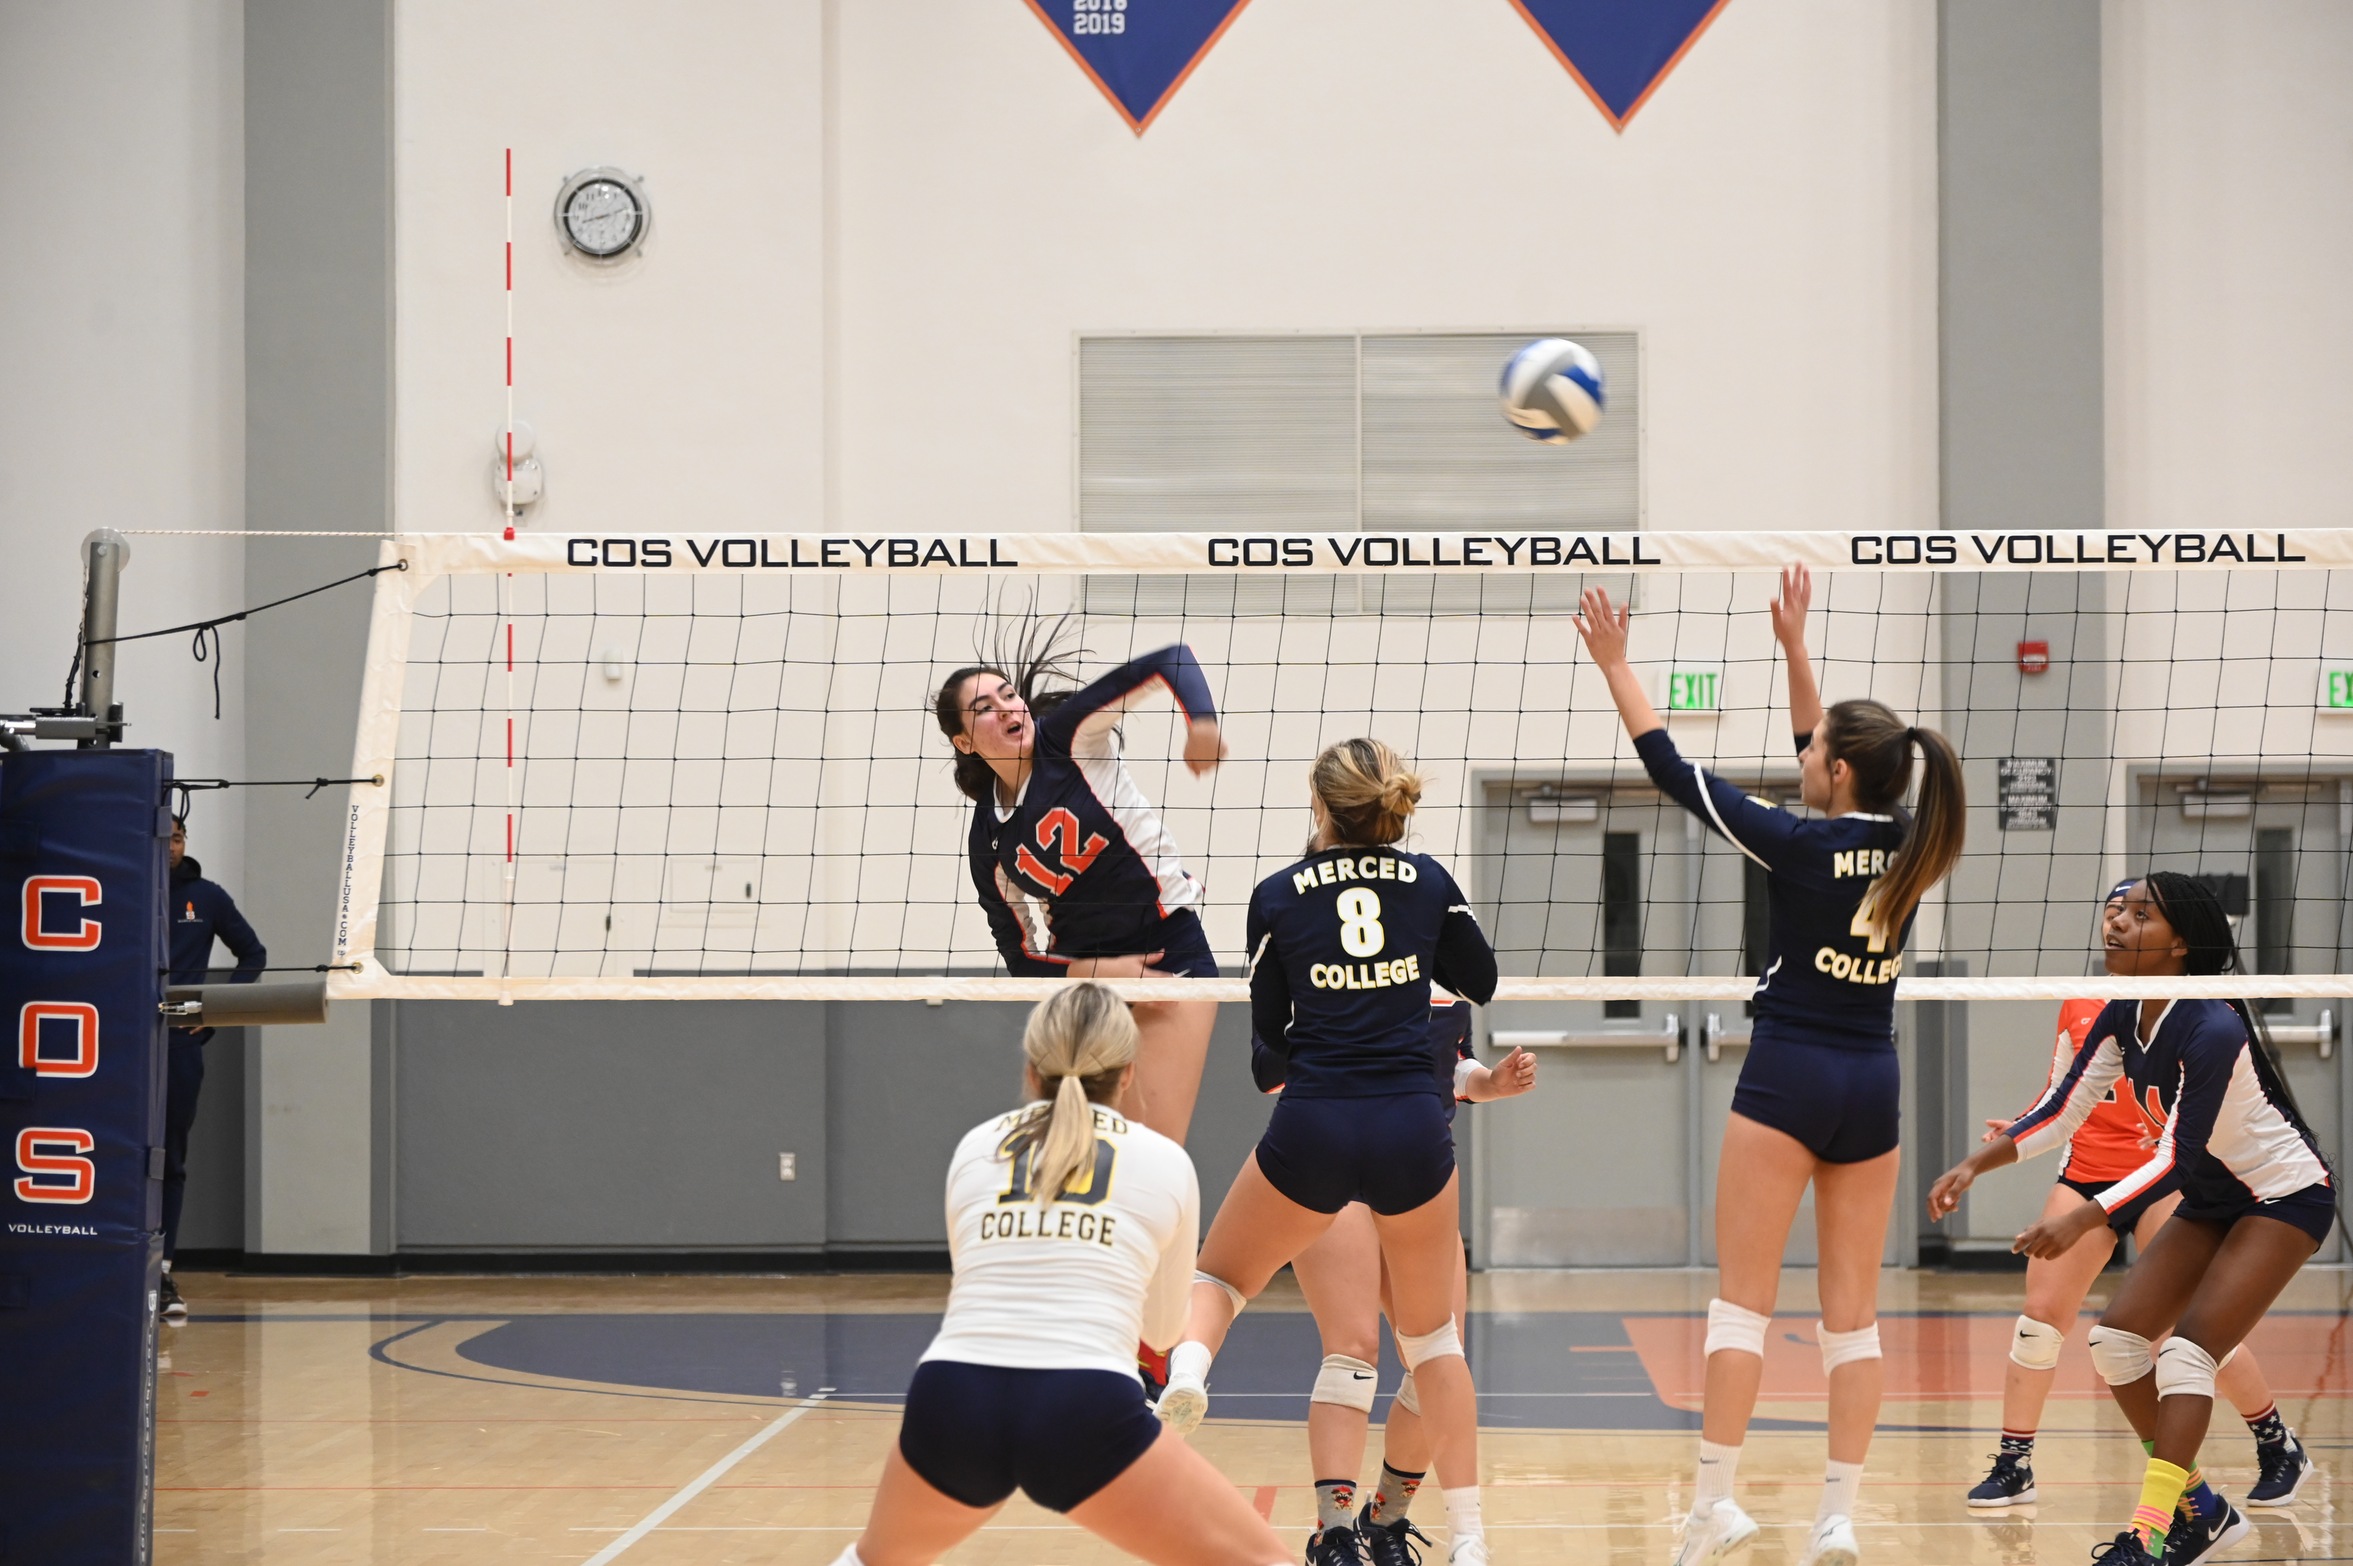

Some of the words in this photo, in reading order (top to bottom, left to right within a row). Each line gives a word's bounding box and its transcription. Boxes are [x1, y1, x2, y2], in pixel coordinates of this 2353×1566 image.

[1074, 12, 1126, 35] 2019
[567, 538, 672, 568] COS
[686, 538, 1019, 568] VOLLEYBALL
[1208, 537, 1314, 567] COS
[1327, 536, 1661, 567] VOLLEYBALL
[1851, 535, 1957, 565] COS
[1971, 533, 2307, 564] VOLLEYBALL
[1669, 673, 1718, 709] EXIT
[1015, 807, 1110, 897] 12
[1292, 856, 1418, 895] MERCED
[1336, 886, 1385, 958] 8
[1850, 879, 1890, 953] 4
[1310, 954, 1421, 990] COLLEGE
[8, 1223, 98, 1236] VOLLEYBALL
[980, 1210, 1117, 1247] COLLEGE
